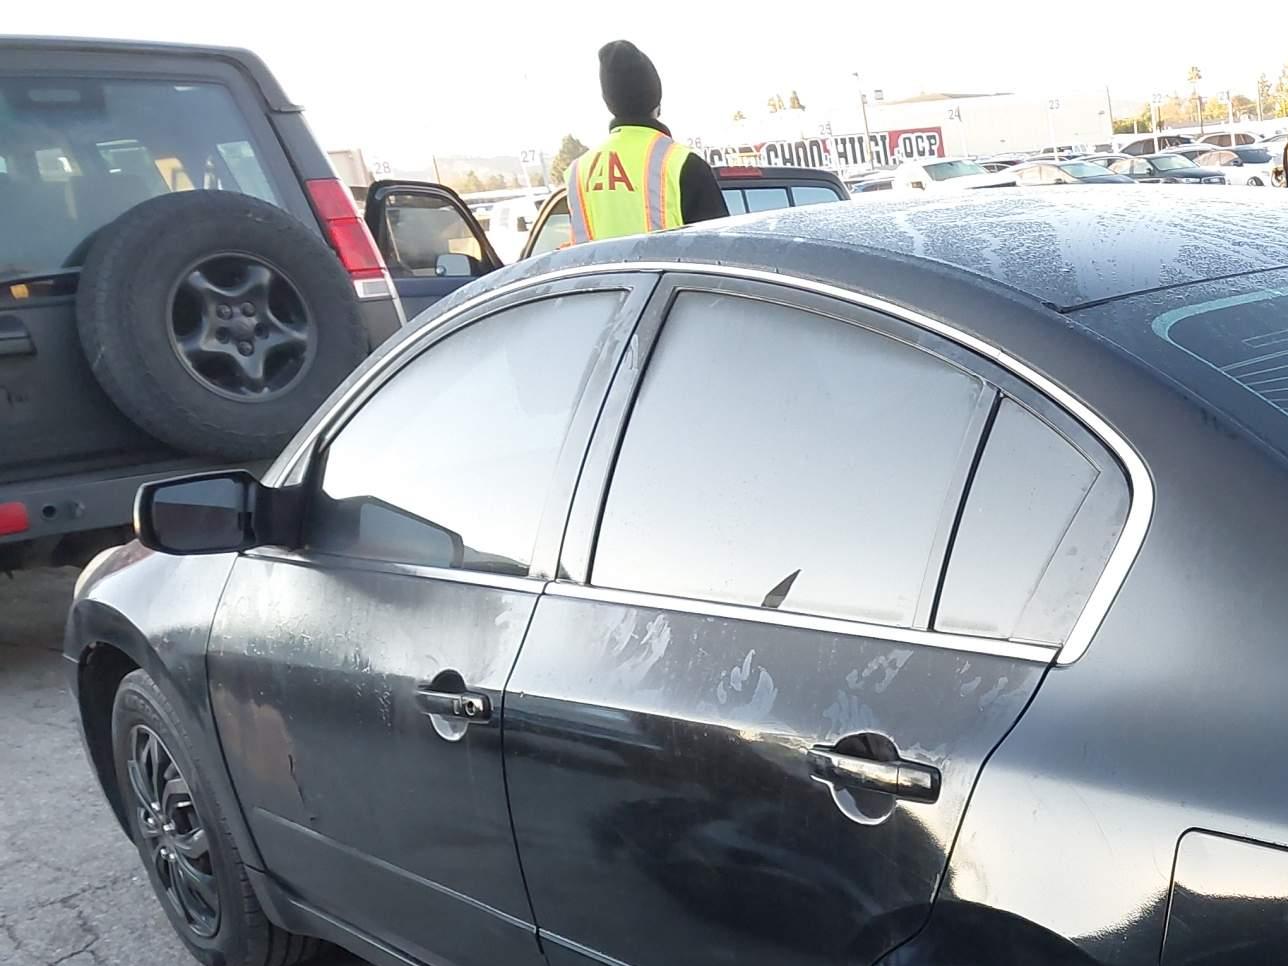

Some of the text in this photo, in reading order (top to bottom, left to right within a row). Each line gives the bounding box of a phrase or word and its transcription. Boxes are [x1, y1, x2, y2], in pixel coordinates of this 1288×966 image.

[1048, 98, 1061, 110] 23
[520, 149, 536, 163] 27
[373, 160, 392, 175] 28
